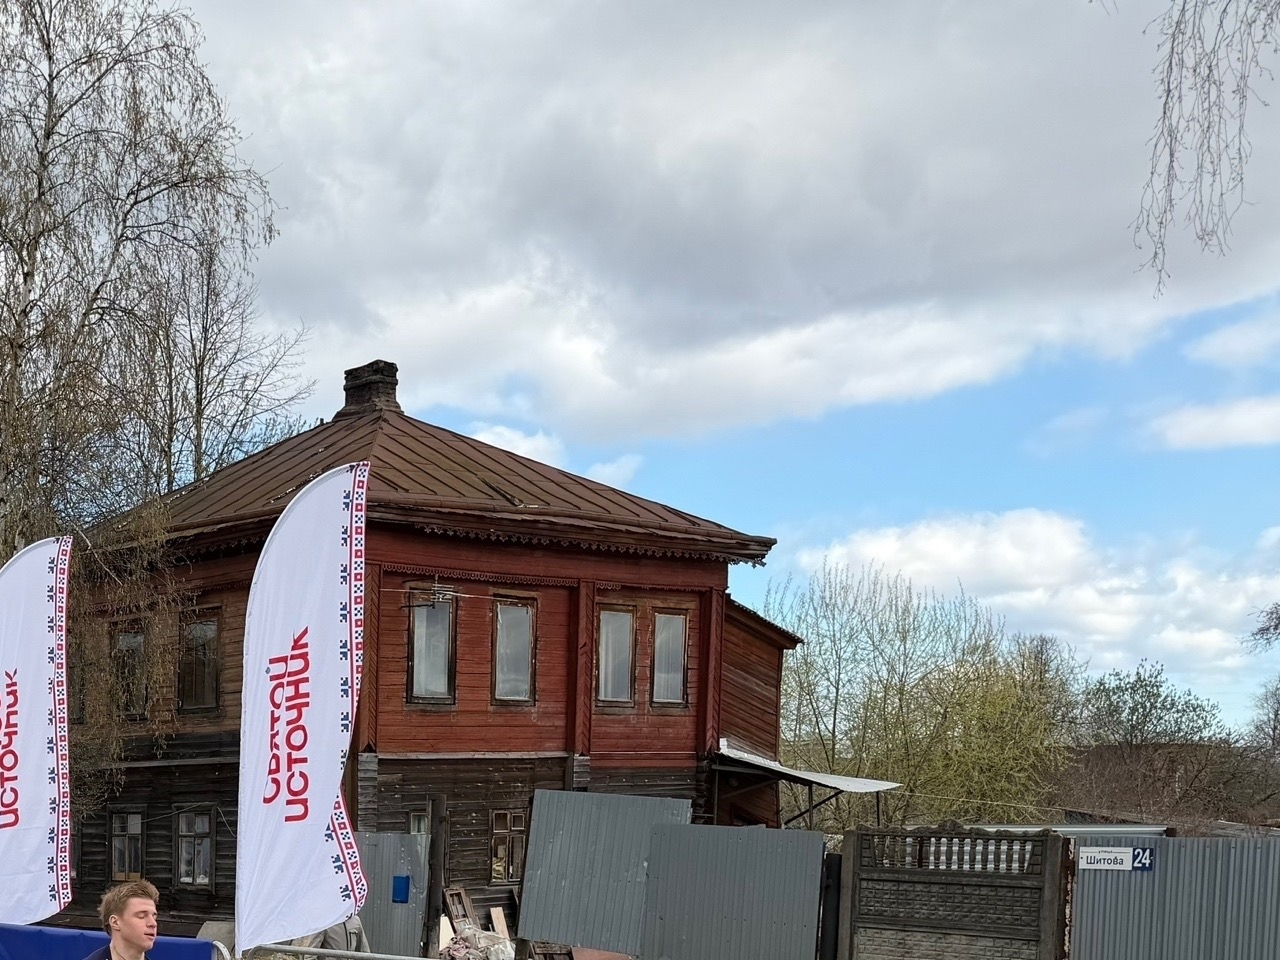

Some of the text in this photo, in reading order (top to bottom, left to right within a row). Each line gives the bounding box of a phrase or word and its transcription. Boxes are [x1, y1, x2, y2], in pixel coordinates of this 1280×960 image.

[284, 626, 310, 822] ИСТОЧНИК
[1086, 856, 1124, 865] Шитова
[1133, 848, 1151, 867] 24
